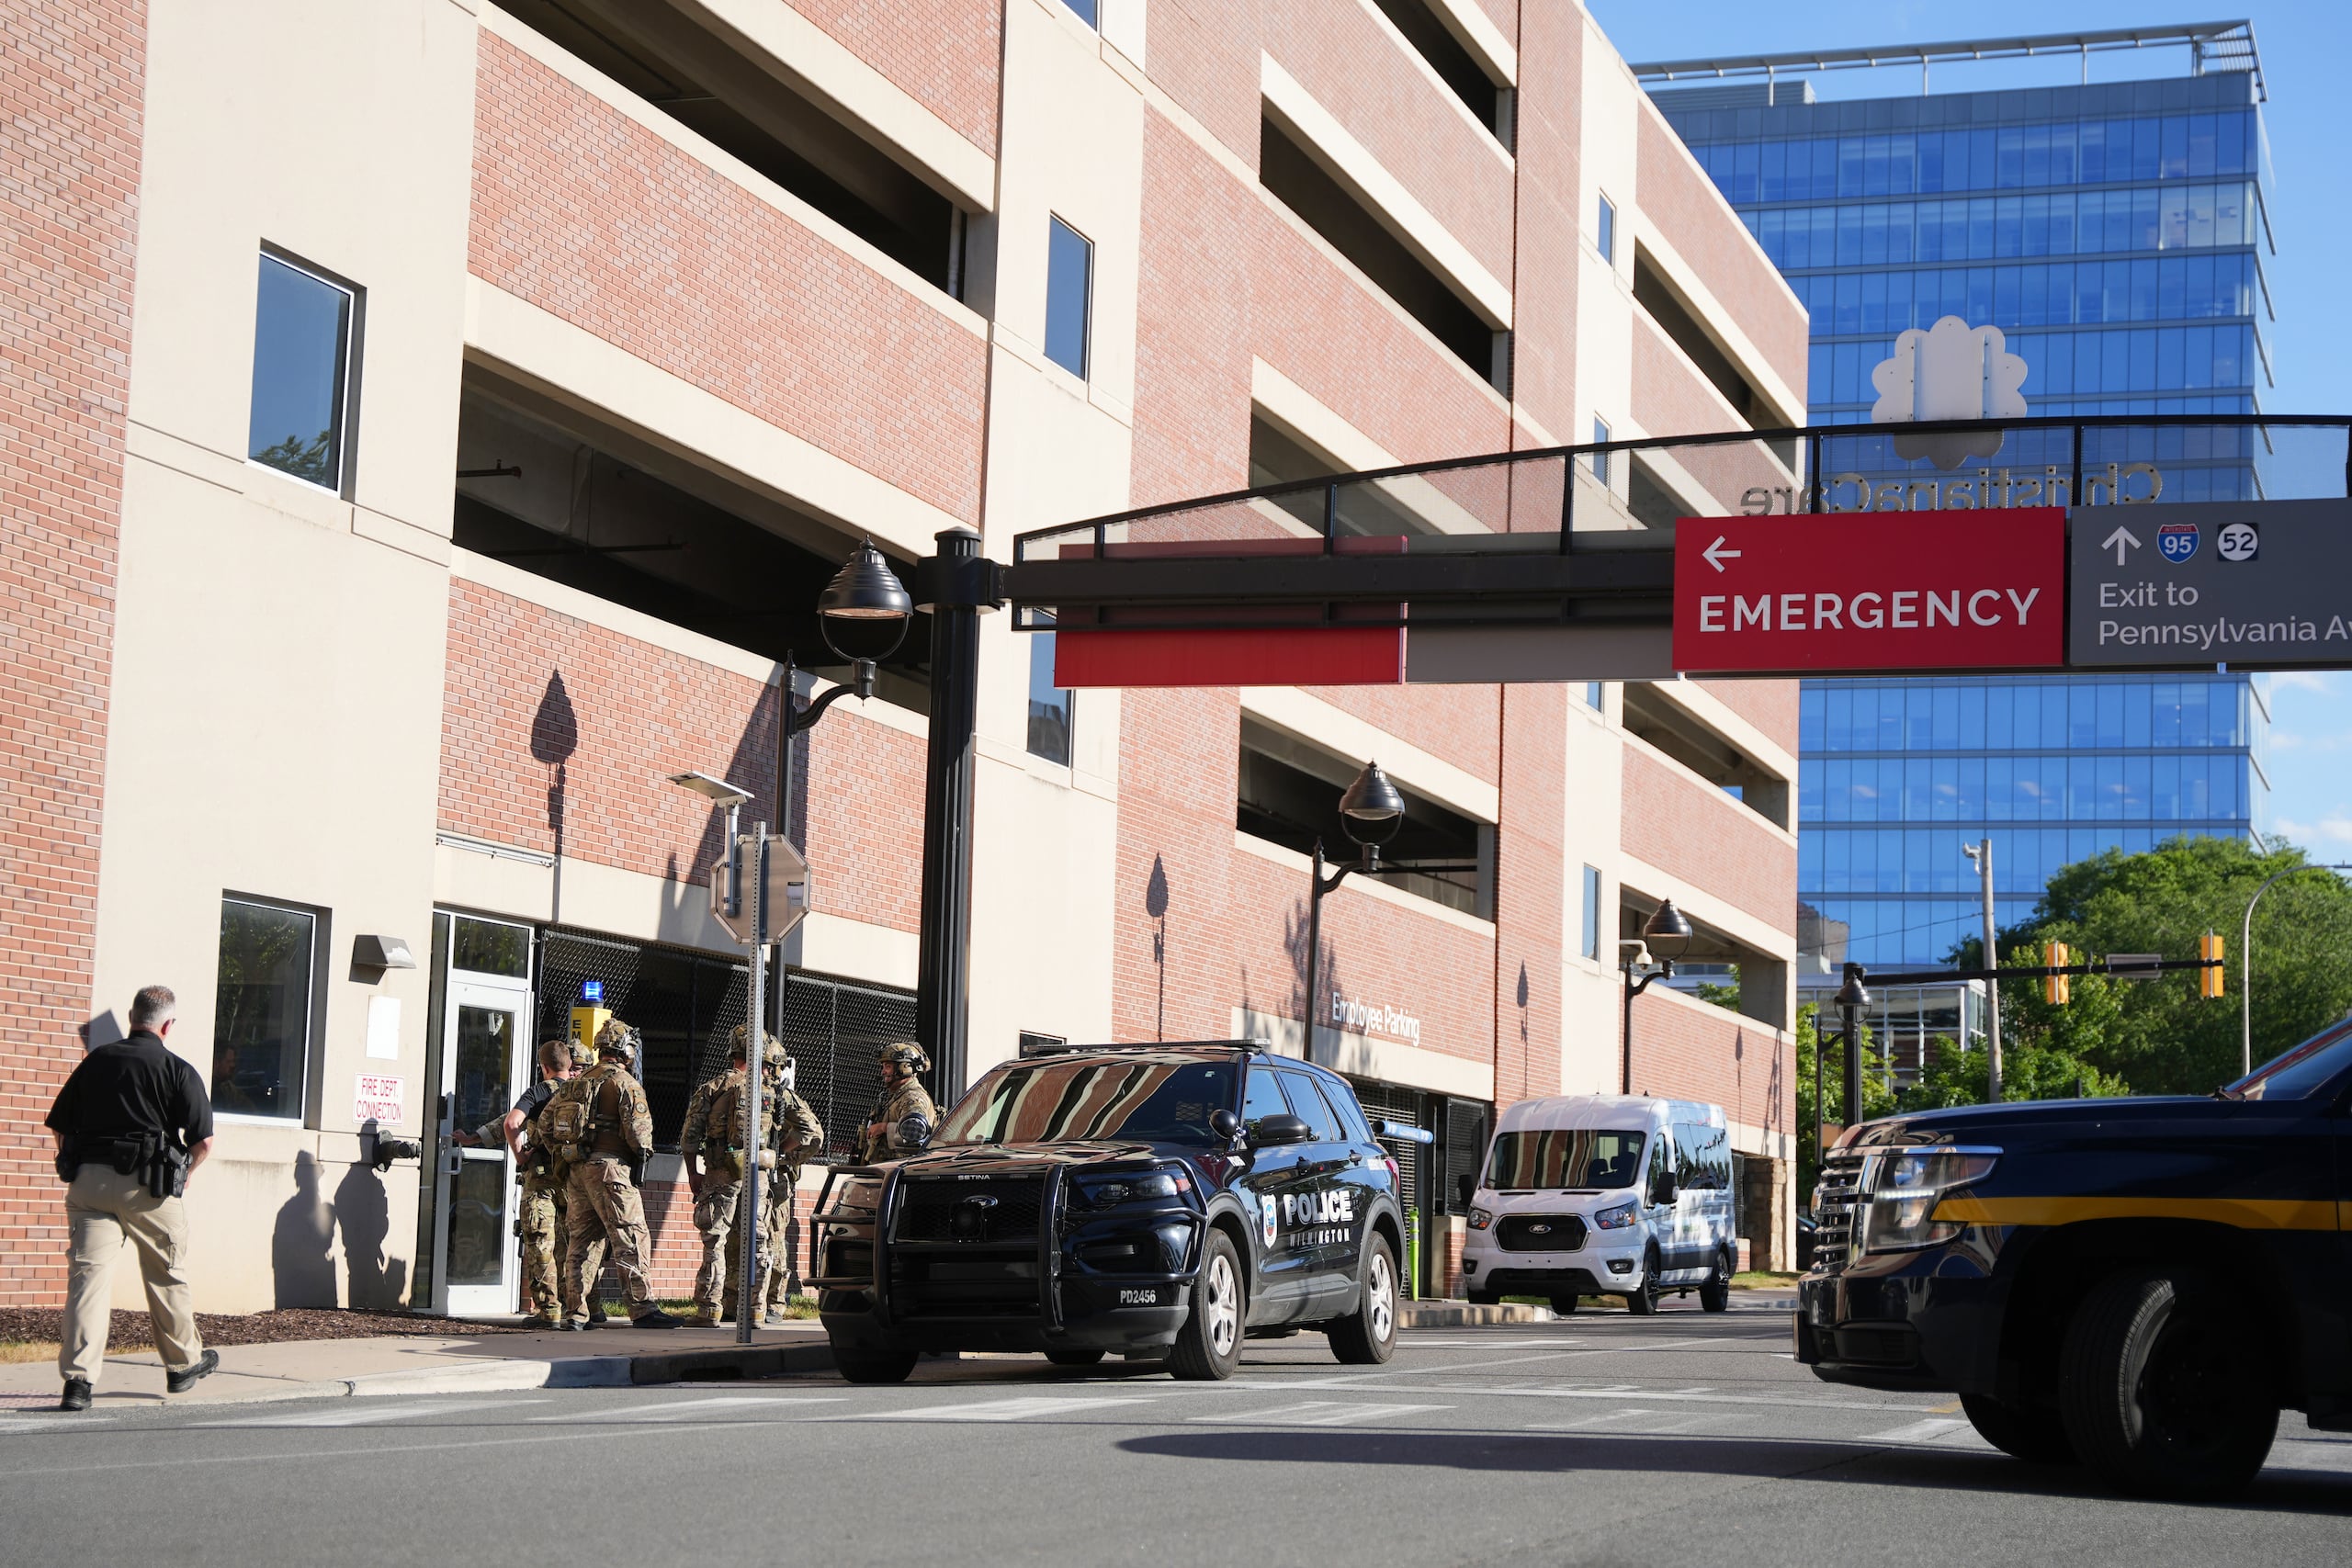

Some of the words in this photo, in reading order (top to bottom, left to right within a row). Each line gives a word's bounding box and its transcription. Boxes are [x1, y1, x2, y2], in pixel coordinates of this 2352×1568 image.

[2164, 536, 2192, 555] 95
[2223, 532, 2255, 552] 52
[2099, 581, 2158, 608] Exit
[2165, 581, 2199, 606] to
[1699, 587, 2041, 632] EMERGENCY
[2098, 616, 2318, 650] Pennsylvania
[2324, 615, 2352, 640] A
[1332, 991, 1383, 1036] Employee
[1385, 1004, 1420, 1047] Parking
[361, 1077, 378, 1096] FIRE
[356, 1100, 401, 1121] CONNECTION
[1283, 1190, 1353, 1225] POLICE
[1289, 1227, 1350, 1247] WILMINGTON
[1120, 1289, 1157, 1303] PD2456
